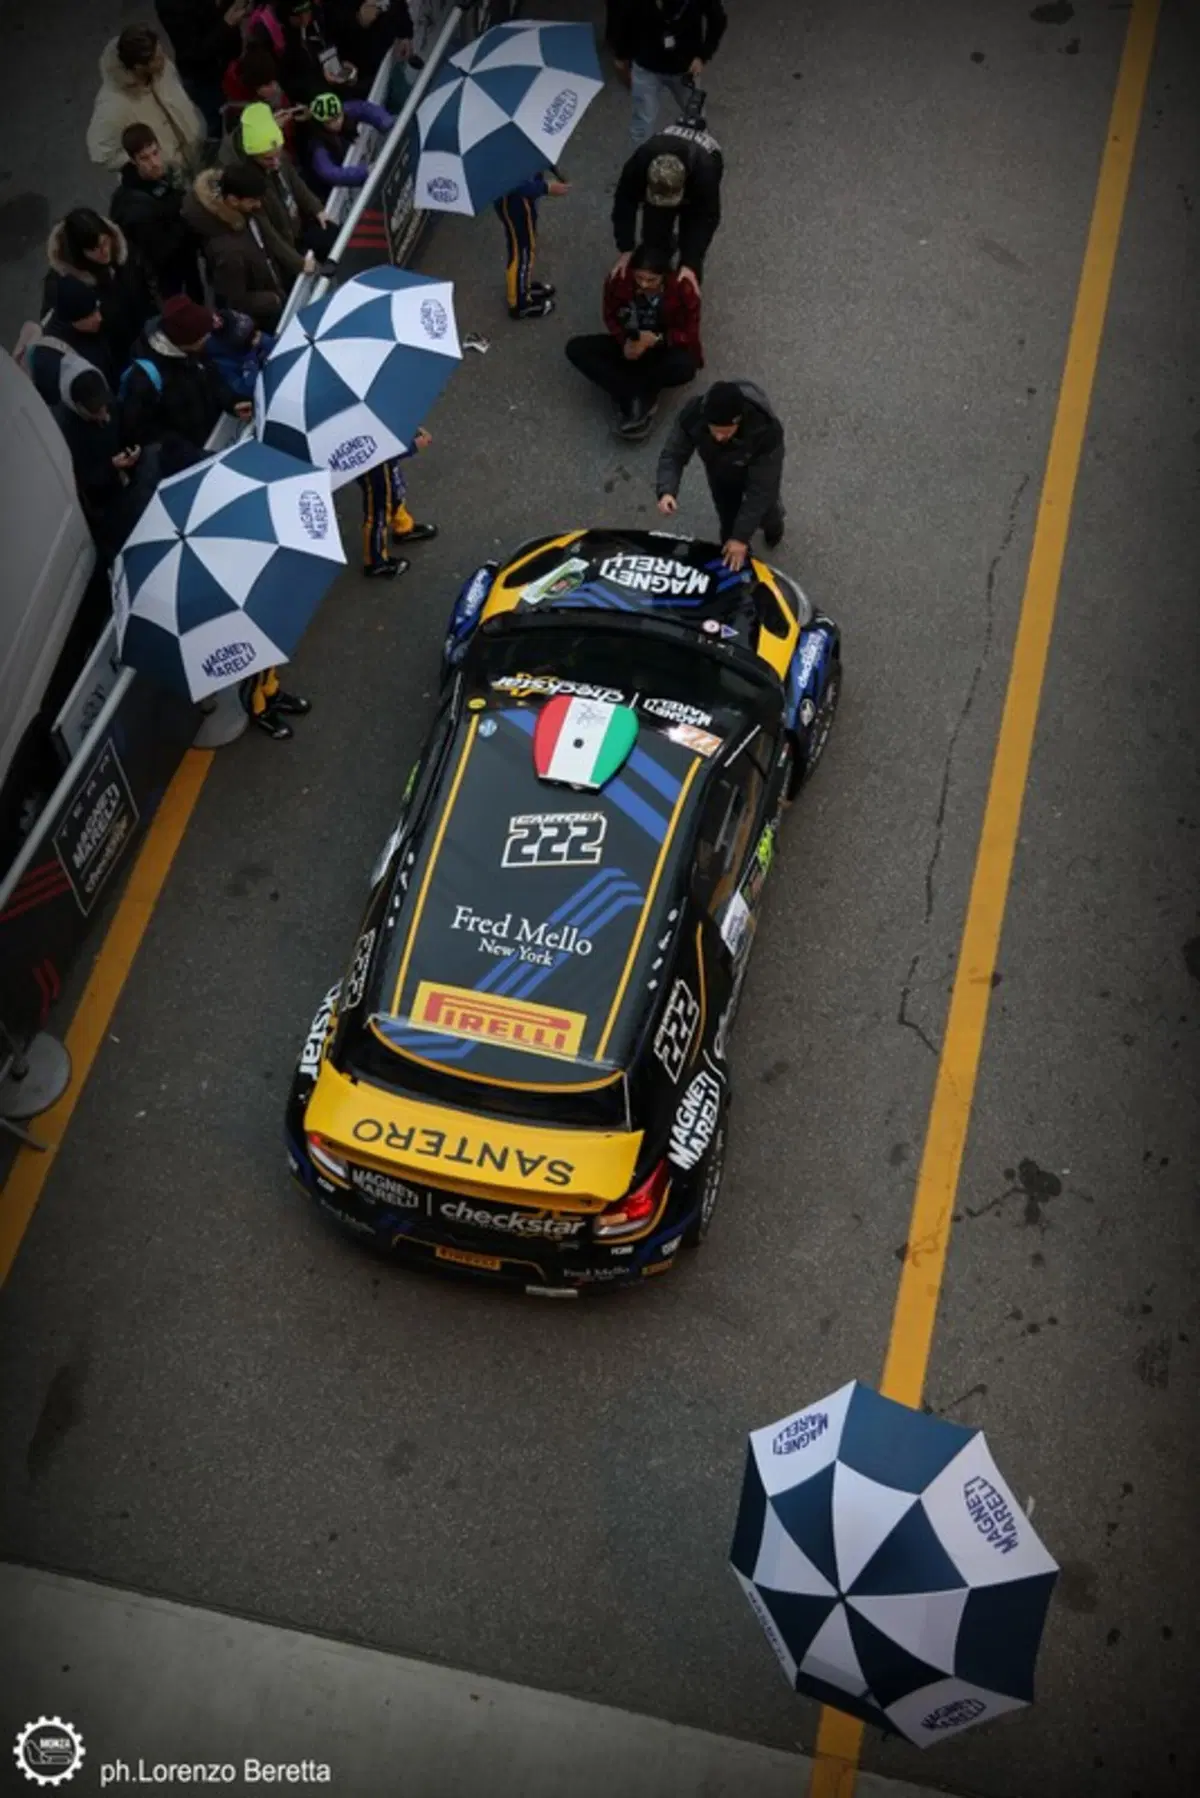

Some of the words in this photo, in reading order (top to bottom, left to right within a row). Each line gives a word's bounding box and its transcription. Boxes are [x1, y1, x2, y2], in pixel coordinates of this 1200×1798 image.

[313, 95, 338, 117] 46
[599, 564, 709, 594] MAGNETI
[501, 815, 607, 868] 222
[451, 904, 514, 941] Fred
[517, 918, 593, 957] Mello
[478, 937, 515, 958] New
[517, 945, 554, 968] York
[423, 991, 573, 1051] PIRELLI
[668, 1071, 713, 1170] MAGNETI
[352, 1117, 576, 1187] SANTERO
[440, 1202, 587, 1236] checkstar
[963, 1477, 1012, 1555] MAGNETI
[970, 1475, 1019, 1555] MARELLI
